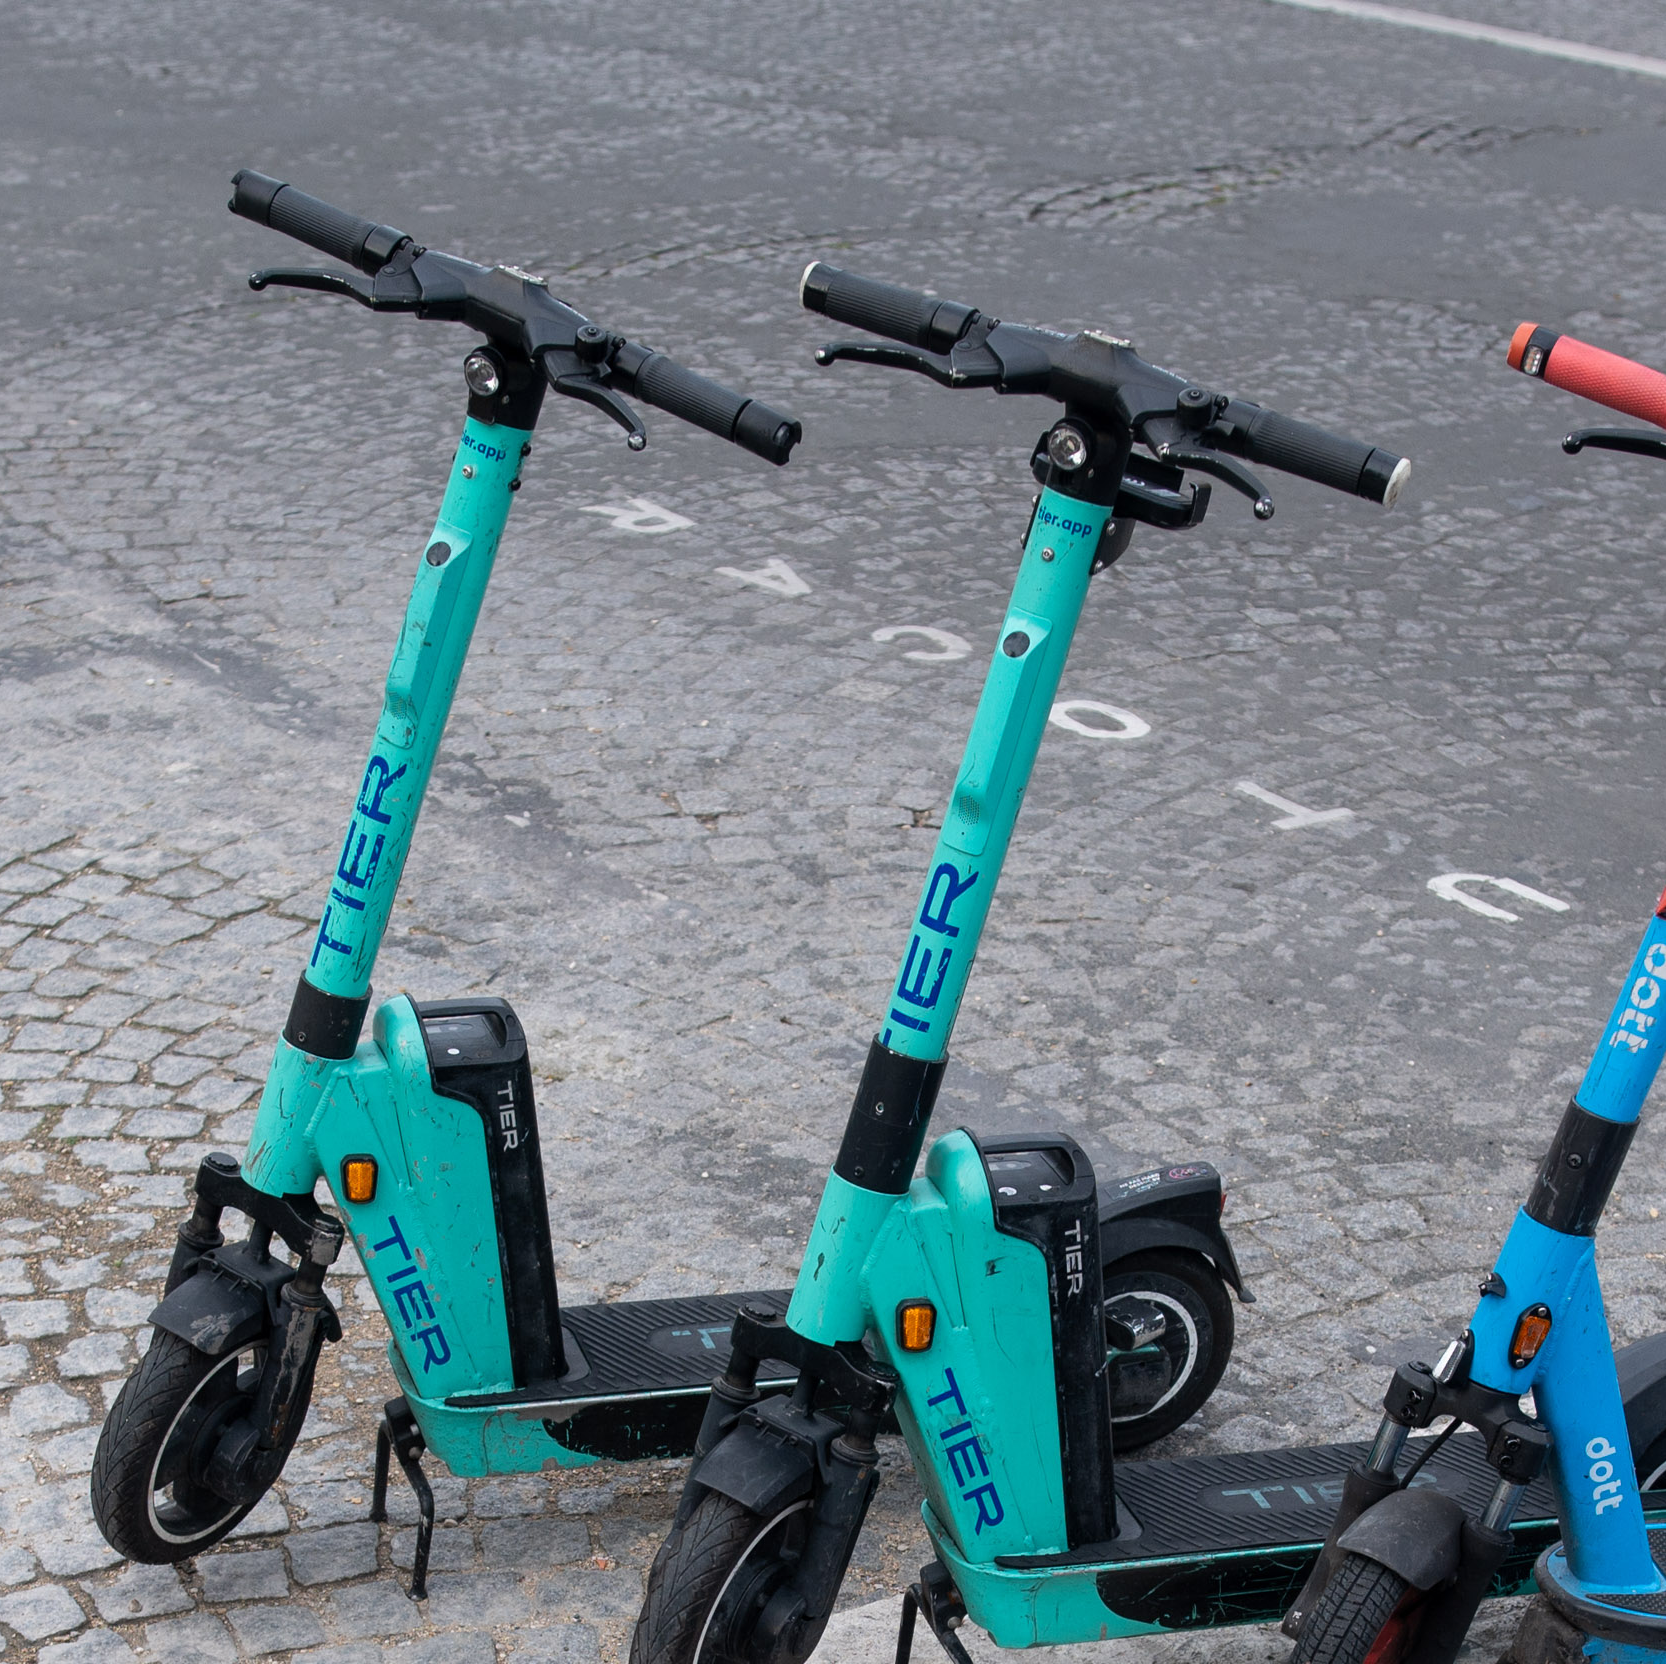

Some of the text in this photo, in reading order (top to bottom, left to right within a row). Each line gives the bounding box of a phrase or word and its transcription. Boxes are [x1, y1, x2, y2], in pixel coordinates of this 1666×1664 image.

[1037, 505, 1093, 538] tier.app
[311, 755, 407, 968] TIER
[497, 1080, 518, 1152] TIER
[373, 1215, 452, 1375] TIER
[1064, 1219, 1084, 1297] TIER
[927, 1367, 1005, 1536] TIER
[1585, 1436, 1624, 1516] dott
